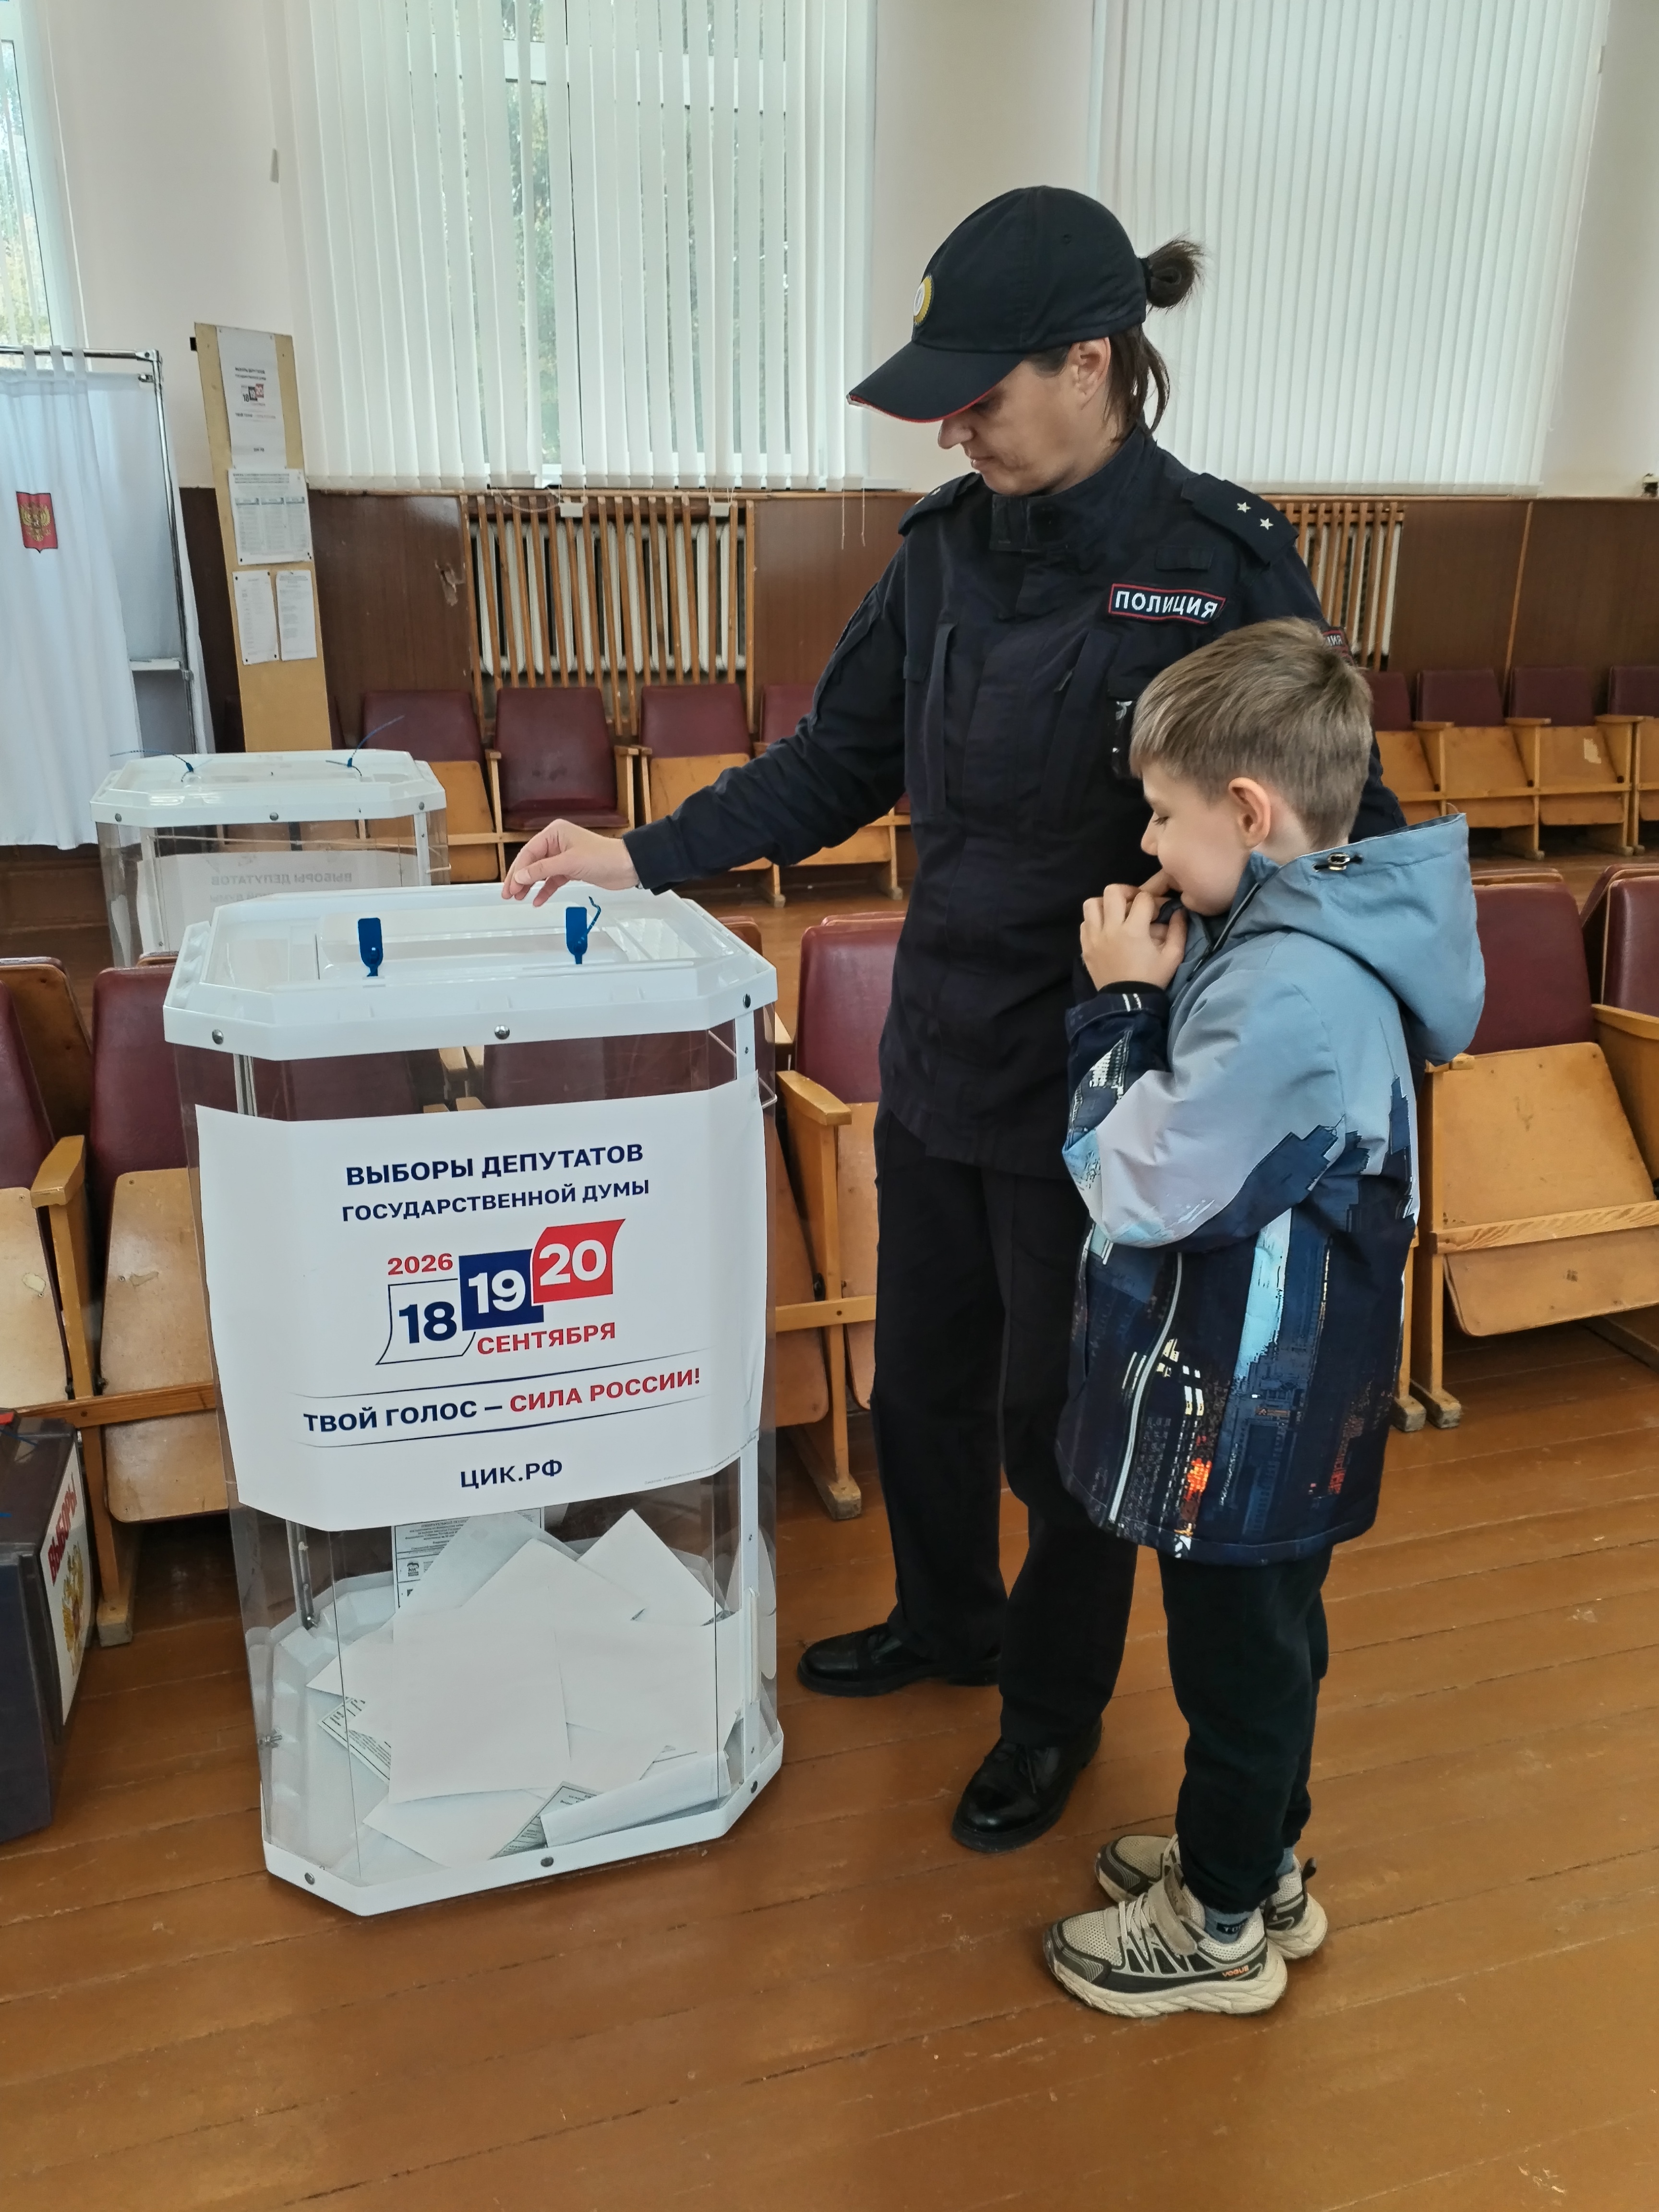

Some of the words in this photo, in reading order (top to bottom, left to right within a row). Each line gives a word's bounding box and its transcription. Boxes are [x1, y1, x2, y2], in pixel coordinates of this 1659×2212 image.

[243, 394, 249, 402] 18
[1115, 590, 1218, 618] ПОЛИЦИЯ
[346, 1158, 473, 1186] ВЫБОРЫ
[481, 1143, 643, 1179] ДЕПУТАТОВ
[342, 1183, 576, 1222] ГОСУДАРСТВЕННОЙ
[582, 1179, 649, 1203] ДУМЫ
[387, 1253, 453, 1275] 2026
[538, 1239, 607, 1286] 20
[468, 1269, 526, 1314] 19
[399, 1301, 457, 1344] 18
[477, 1322, 616, 1355] СЕНТЯБРЯ
[303, 1406, 378, 1432] ТВОЙ
[385, 1400, 478, 1426] ГОЛОС
[510, 1387, 583, 1413] СИЛА
[590, 1368, 700, 1402] РОССИИ!
[460, 1459, 563, 1489] ЦИК.РФ
[1222, 1965, 1249, 1977] VOGUE
